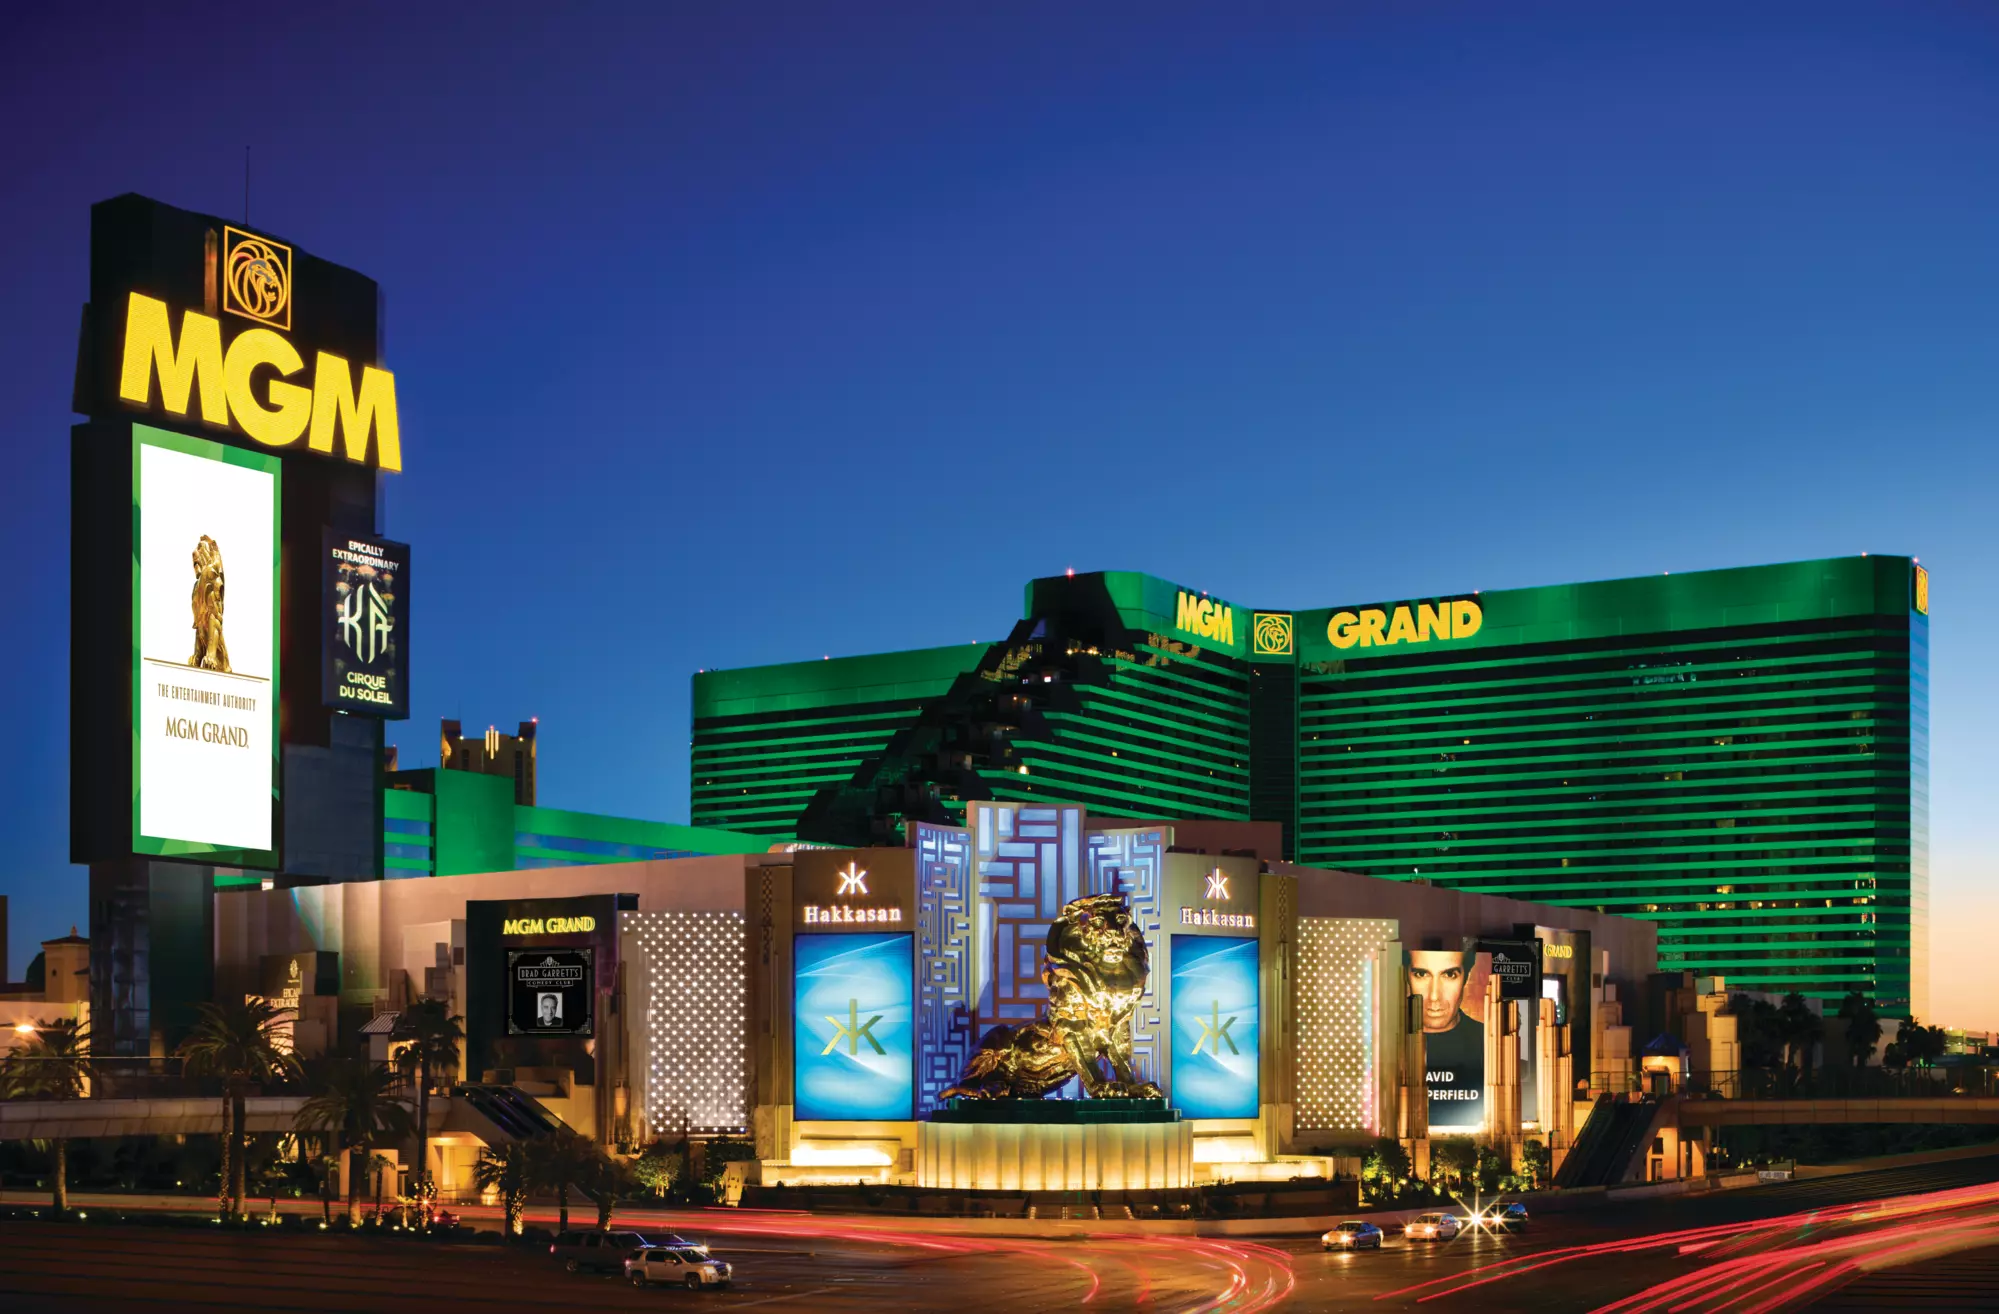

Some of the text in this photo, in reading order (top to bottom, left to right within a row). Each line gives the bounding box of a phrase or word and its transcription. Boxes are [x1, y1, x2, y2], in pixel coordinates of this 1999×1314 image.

[119, 291, 402, 472] MGM
[348, 540, 384, 557] EPICALLY
[332, 548, 400, 571] EXTRAORDINARY
[1176, 591, 1483, 649] MGM GRAND
[346, 671, 386, 690] CIRQUE
[158, 683, 256, 712] THE ENTERTAINMENT AUTHORITY
[339, 685, 393, 704] DU SOLEIL
[165, 716, 248, 748] MGM GRAND
[803, 905, 901, 923] Hakkasan
[1180, 907, 1255, 927] Hakkasan
[502, 916, 596, 935] MGM GRAND
[521, 968, 579, 978] BRAD GARRETT'S
[1493, 964, 1528, 974] GARRETT'S
[1426, 1071, 1454, 1082] AVID
[1428, 1089, 1479, 1100] PERFIELD
